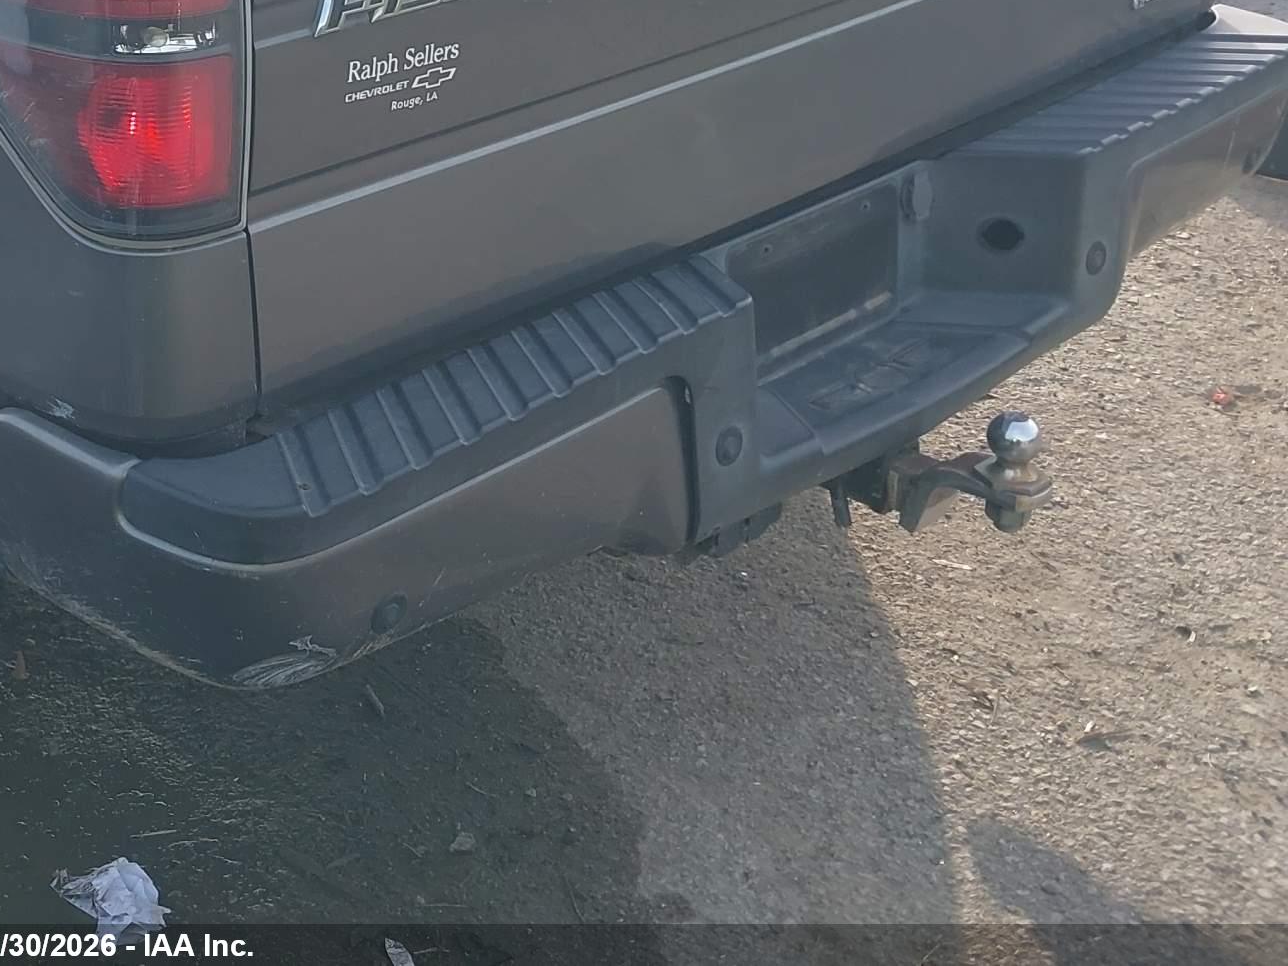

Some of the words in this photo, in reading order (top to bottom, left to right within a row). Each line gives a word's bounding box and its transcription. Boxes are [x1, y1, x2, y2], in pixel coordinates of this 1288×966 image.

[347, 52, 399, 83] Ralph
[403, 42, 460, 70] Sellers
[345, 80, 410, 103] CHEVROLET
[391, 94, 424, 111] Rouge,
[426, 90, 438, 102] LA
